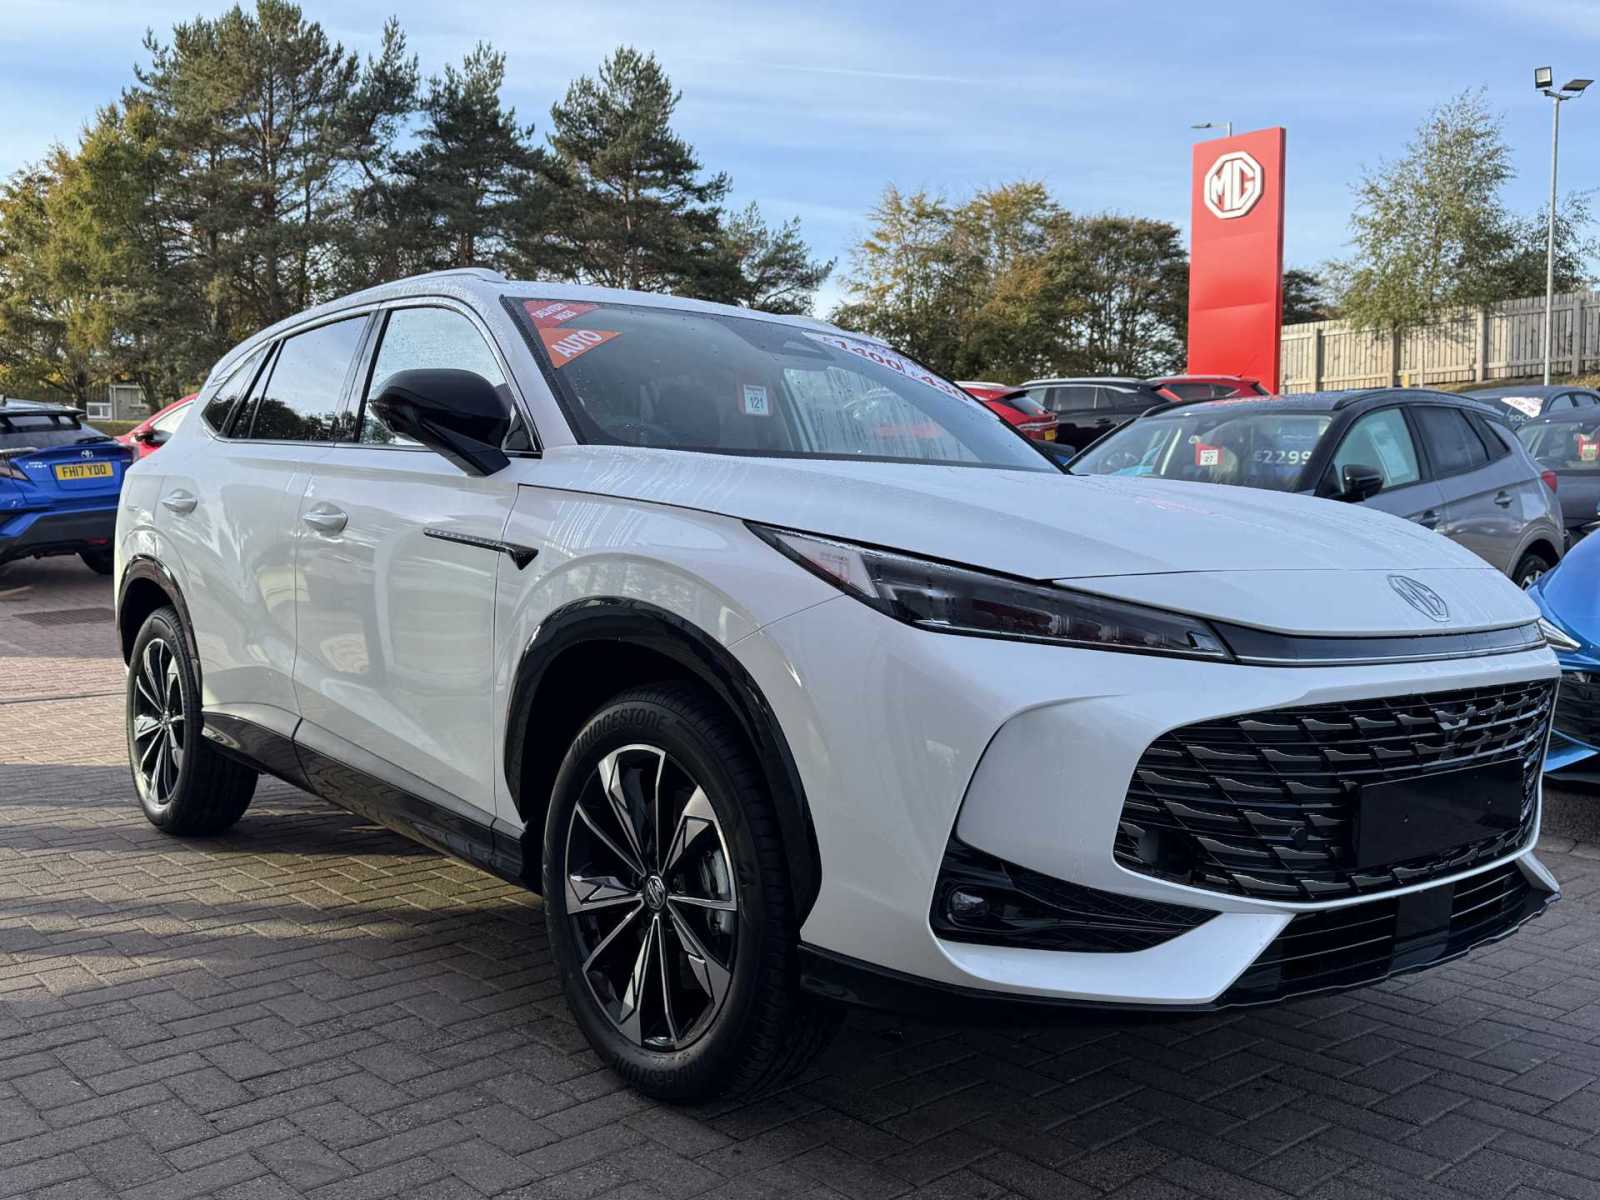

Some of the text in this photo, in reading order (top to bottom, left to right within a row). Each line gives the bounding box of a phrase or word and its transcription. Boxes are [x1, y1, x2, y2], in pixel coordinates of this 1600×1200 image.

[1207, 155, 1259, 214] MG
[551, 329, 603, 358] AUTO
[750, 395, 764, 408] 121
[62, 465, 84, 478] FH17
[1388, 575, 1447, 620] MG
